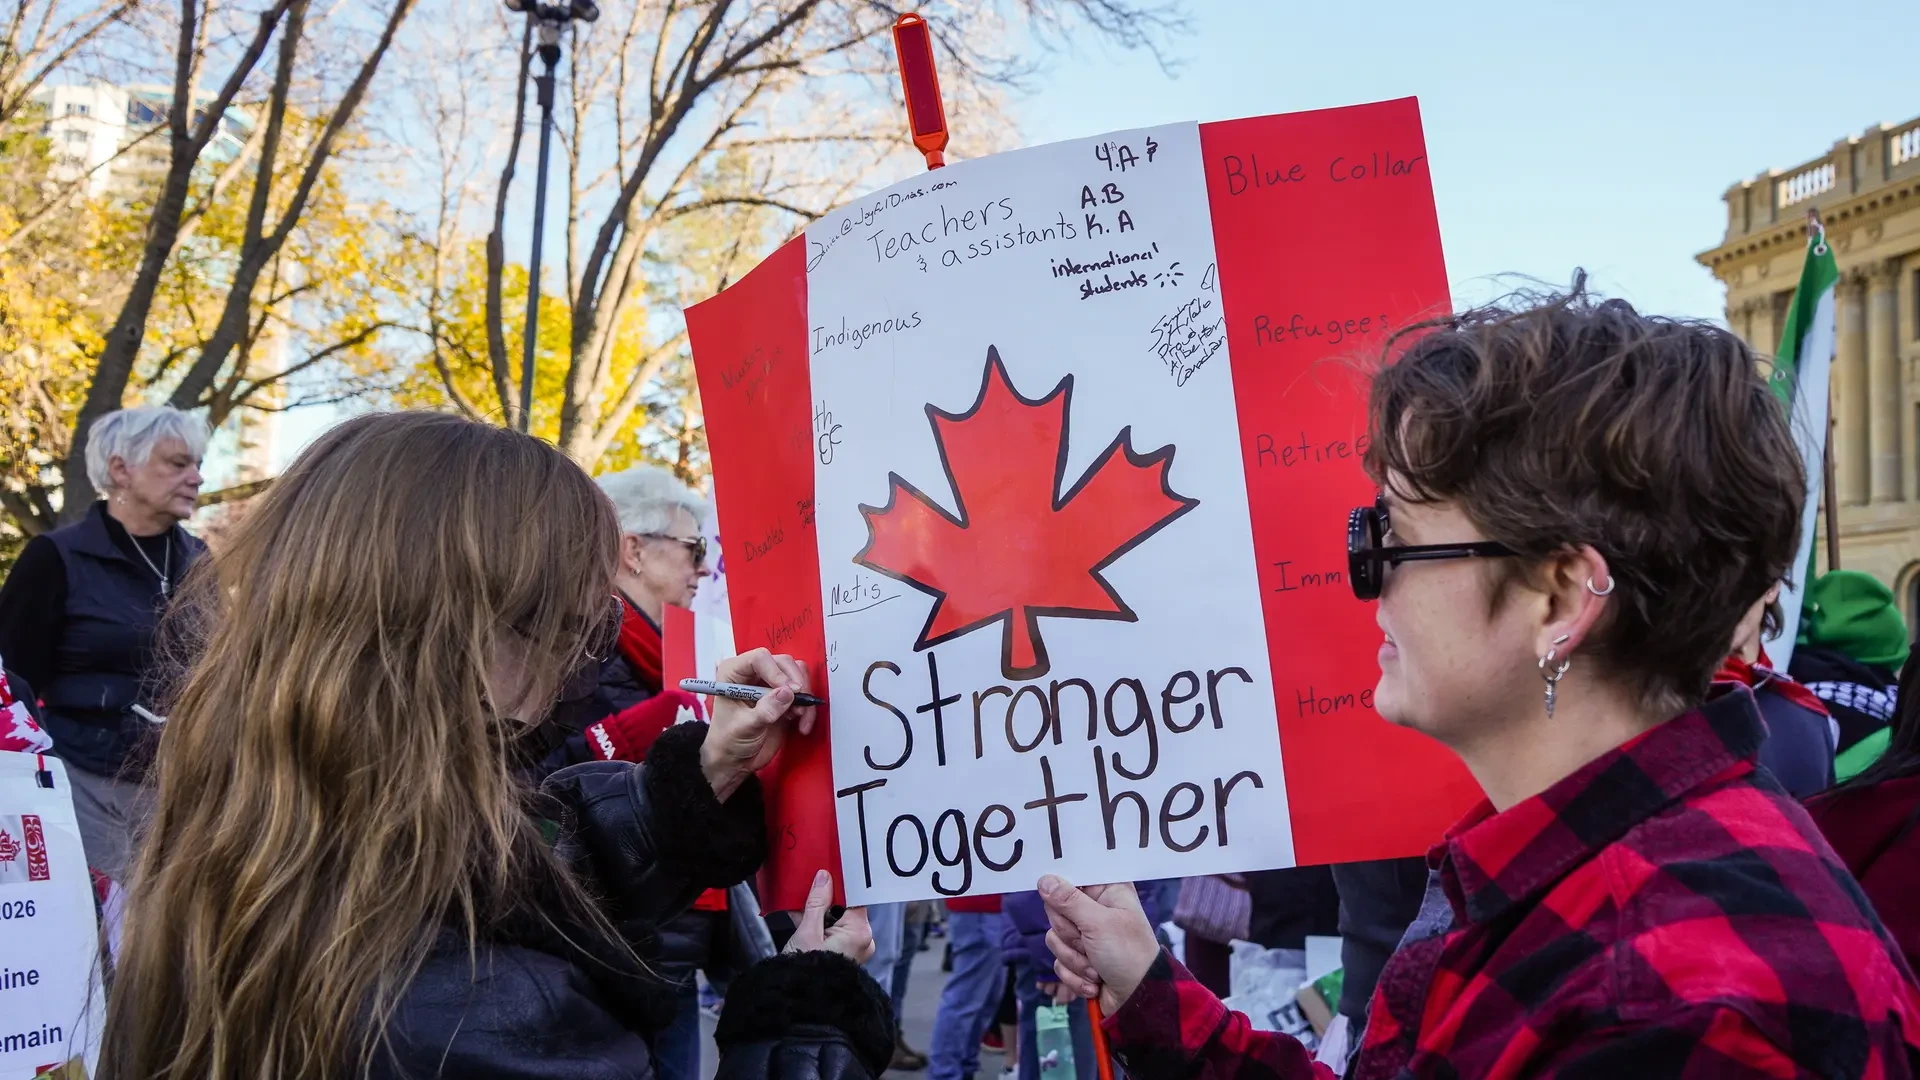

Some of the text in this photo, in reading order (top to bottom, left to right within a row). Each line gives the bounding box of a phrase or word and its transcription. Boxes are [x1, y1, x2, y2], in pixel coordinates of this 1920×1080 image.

[1223, 151, 1424, 196] Blue Collar
[867, 197, 1014, 263] Teachers
[941, 211, 1077, 268] assistants
[1050, 241, 1160, 278] international
[1080, 270, 1148, 301] students
[812, 311, 922, 356] Indigenous
[1254, 313, 1389, 347] Refugees
[831, 574, 881, 612] Metis
[862, 651, 1254, 781] Stronger
[836, 745, 1264, 897] Together
[0, 899, 36, 921] 026
[0, 967, 40, 991] ine
